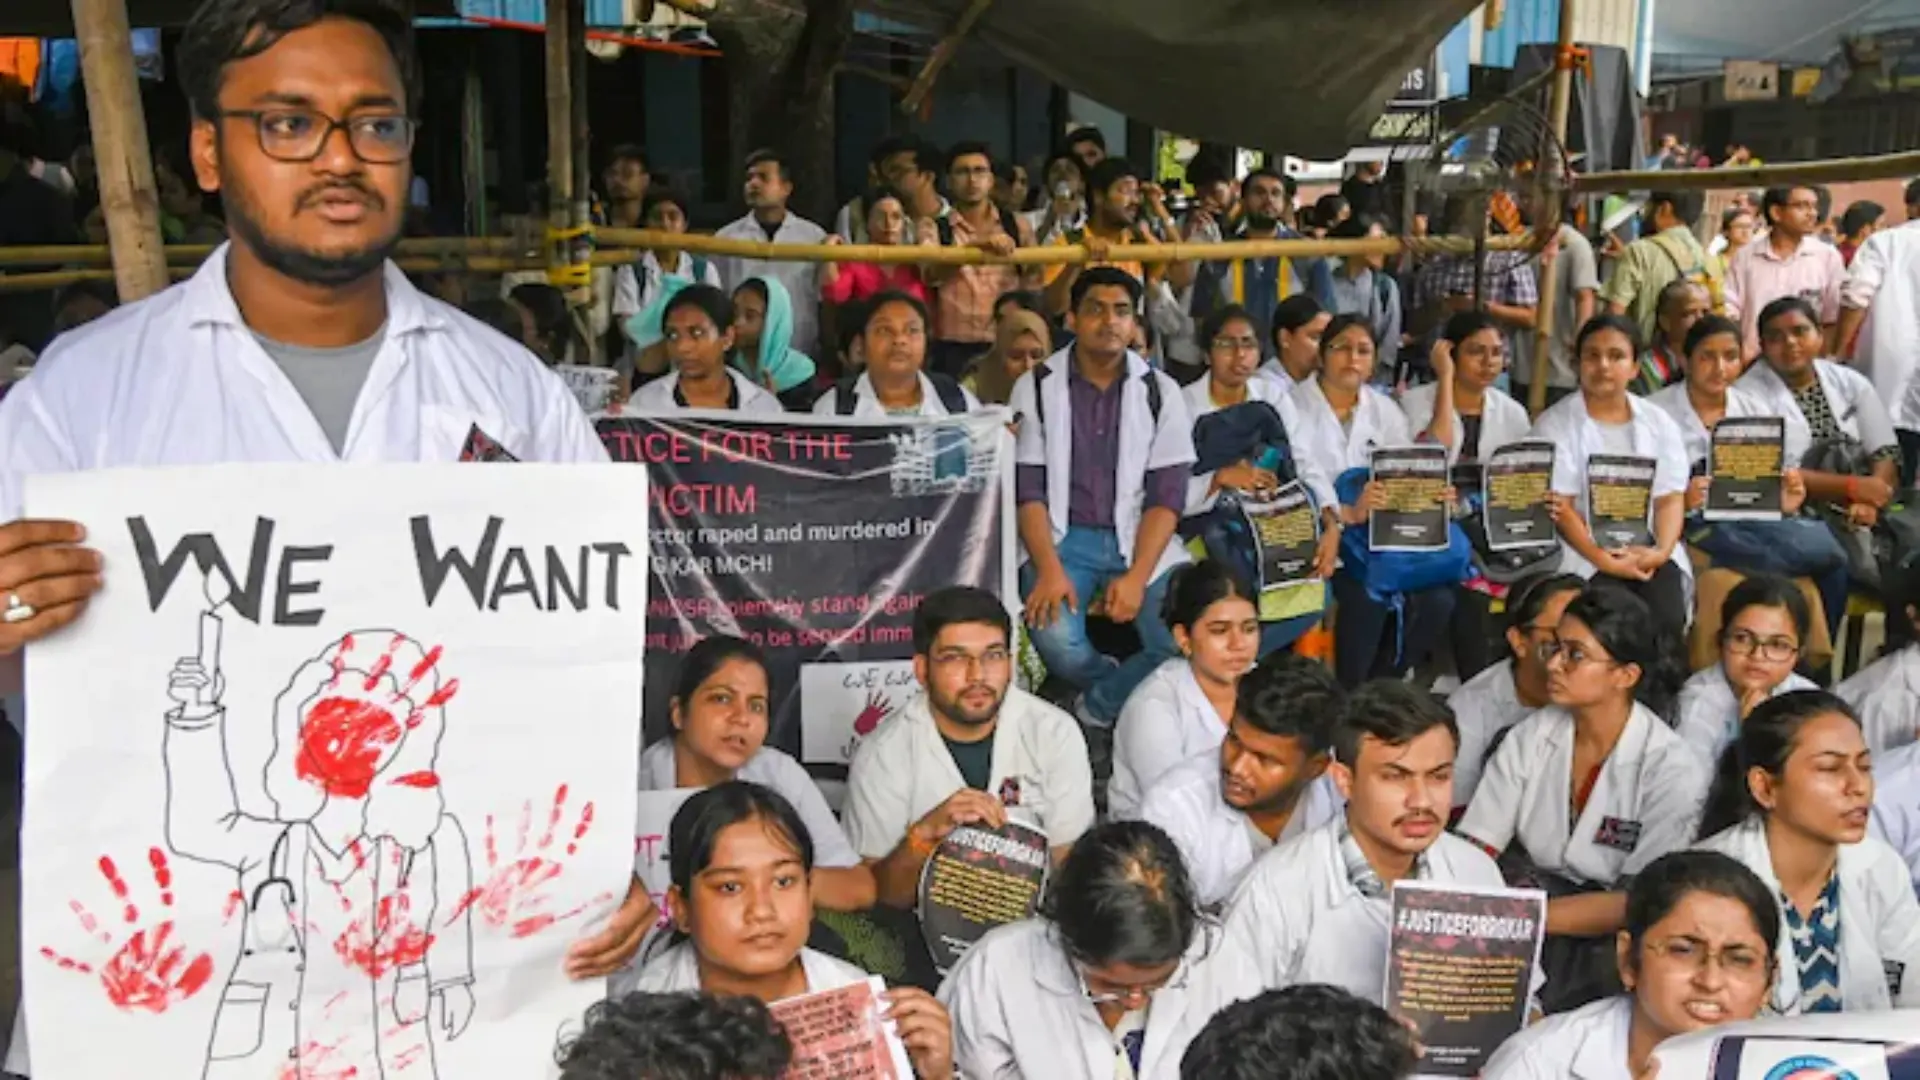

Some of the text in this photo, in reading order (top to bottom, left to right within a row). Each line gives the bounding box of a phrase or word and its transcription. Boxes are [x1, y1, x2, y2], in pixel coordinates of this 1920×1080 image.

[701, 430, 776, 463] FOR
[784, 430, 853, 461] THE
[698, 523, 758, 547] raped
[763, 521, 802, 542] and
[808, 517, 911, 541] murdered
[127, 514, 633, 627] WE WANT
[715, 553, 772, 574] MCH!
[811, 592, 870, 614] stand
[767, 627, 792, 648] be
